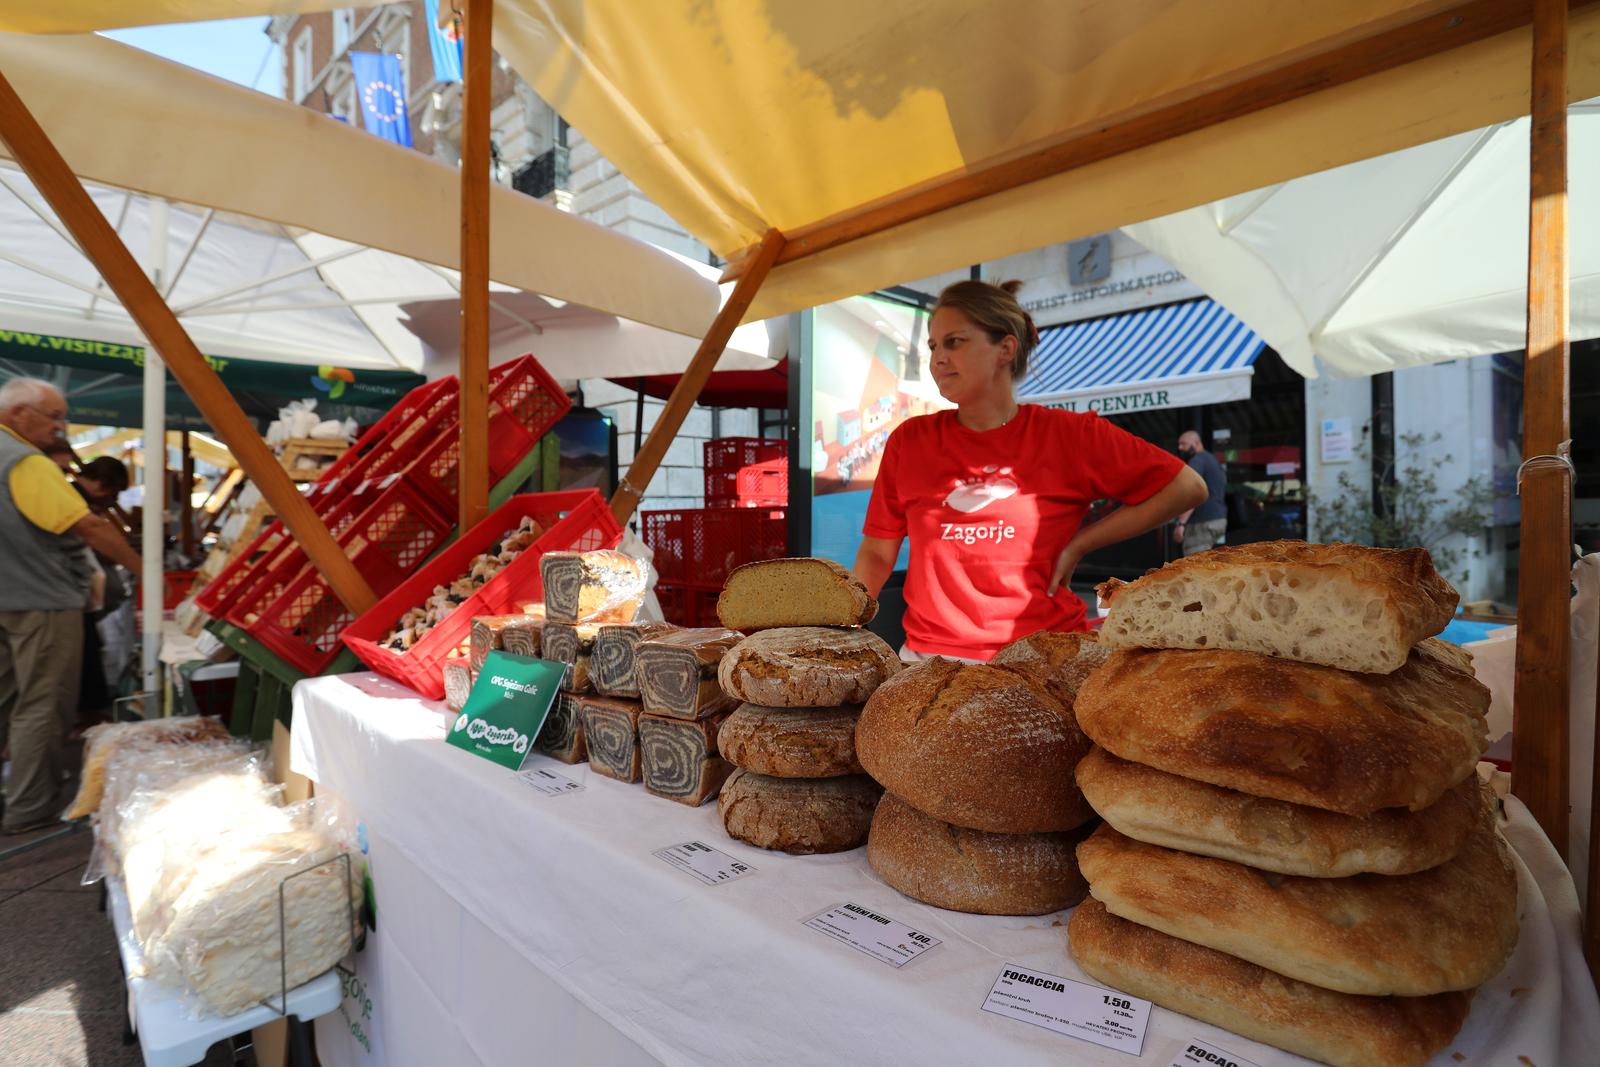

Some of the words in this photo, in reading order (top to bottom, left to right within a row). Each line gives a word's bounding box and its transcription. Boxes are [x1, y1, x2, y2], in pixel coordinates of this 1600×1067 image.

[1022, 295, 1068, 312] URIST
[1088, 391, 1169, 412] CENTAR
[941, 520, 1015, 544] Zagorje
[867, 913, 891, 925] KRUH
[1003, 970, 1065, 993] FOCACCIA
